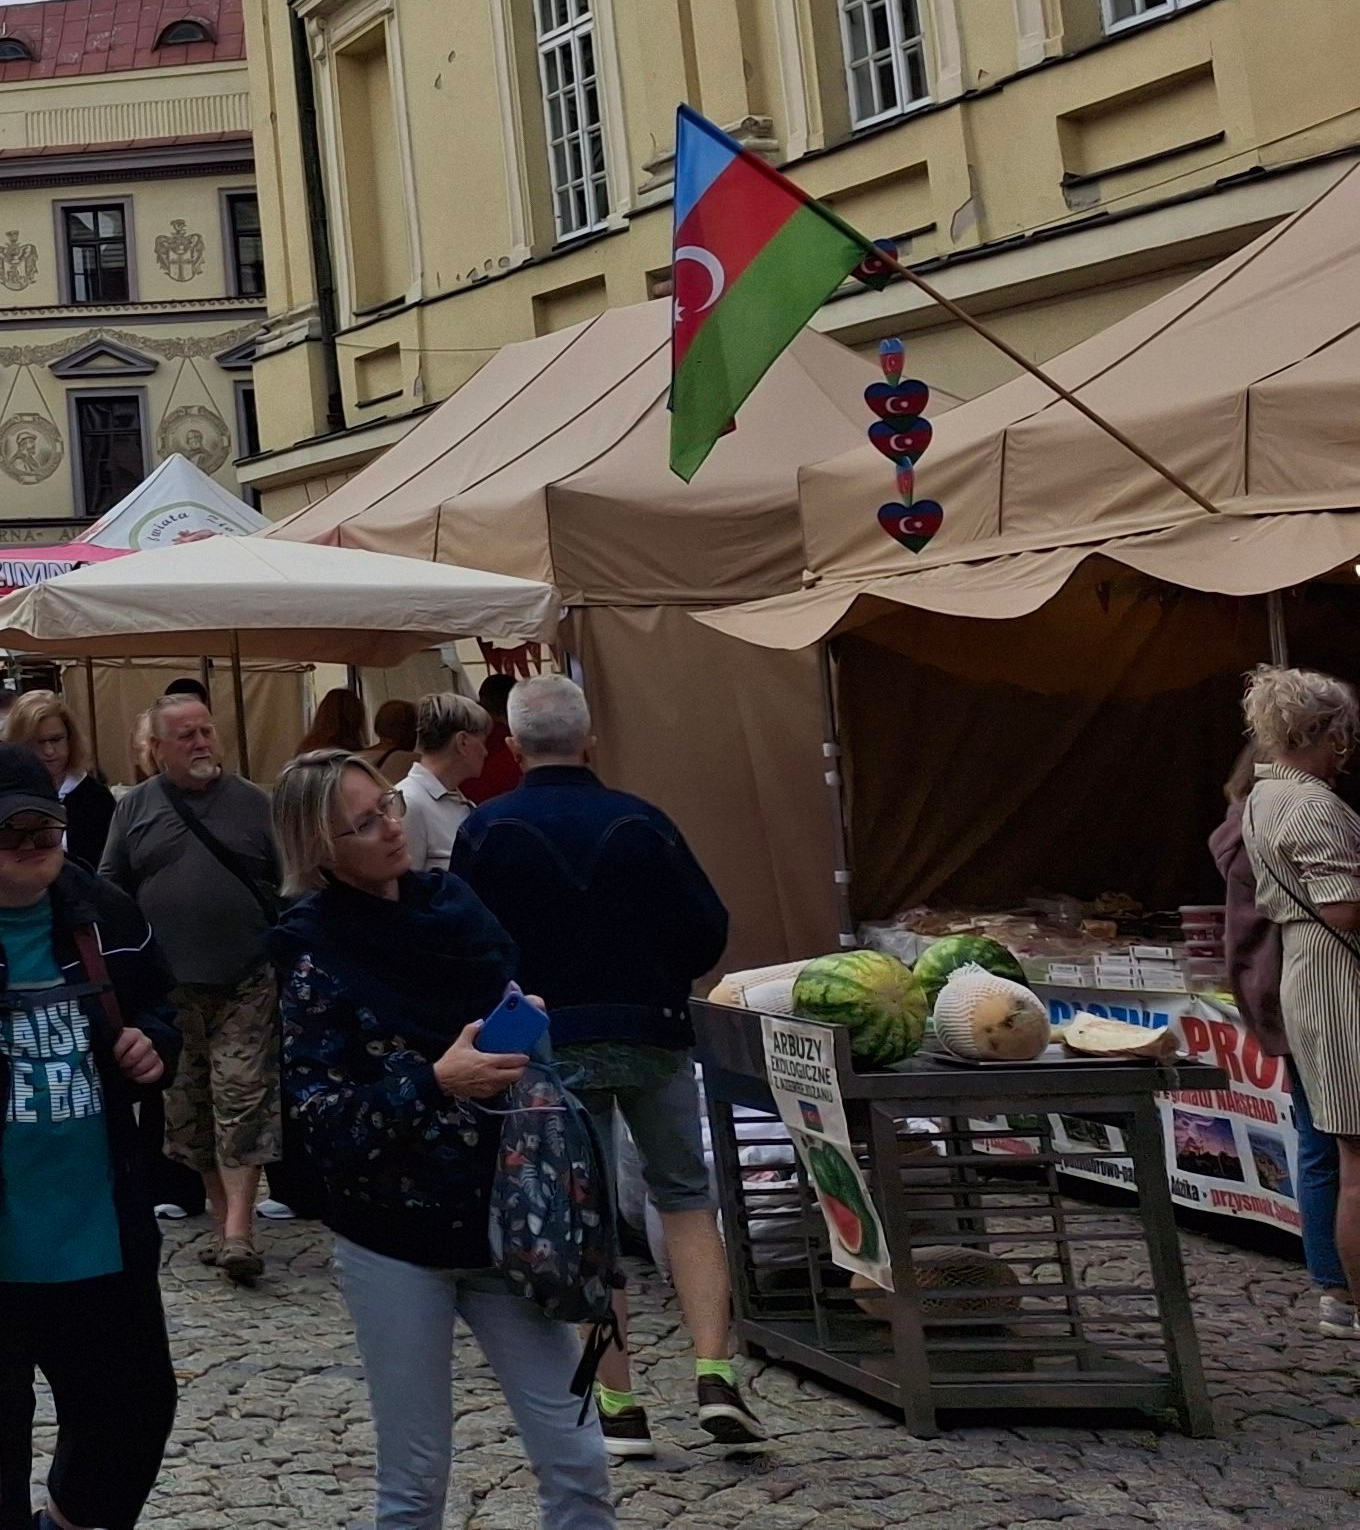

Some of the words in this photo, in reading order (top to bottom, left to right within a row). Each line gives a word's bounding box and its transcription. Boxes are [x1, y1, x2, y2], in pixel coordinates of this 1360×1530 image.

[773, 1031, 821, 1062] ARBUZY
[1179, 1015, 1292, 1095] PRO
[771, 1055, 832, 1085] EKOLOGICZNE
[774, 1076, 781, 1090] Z
